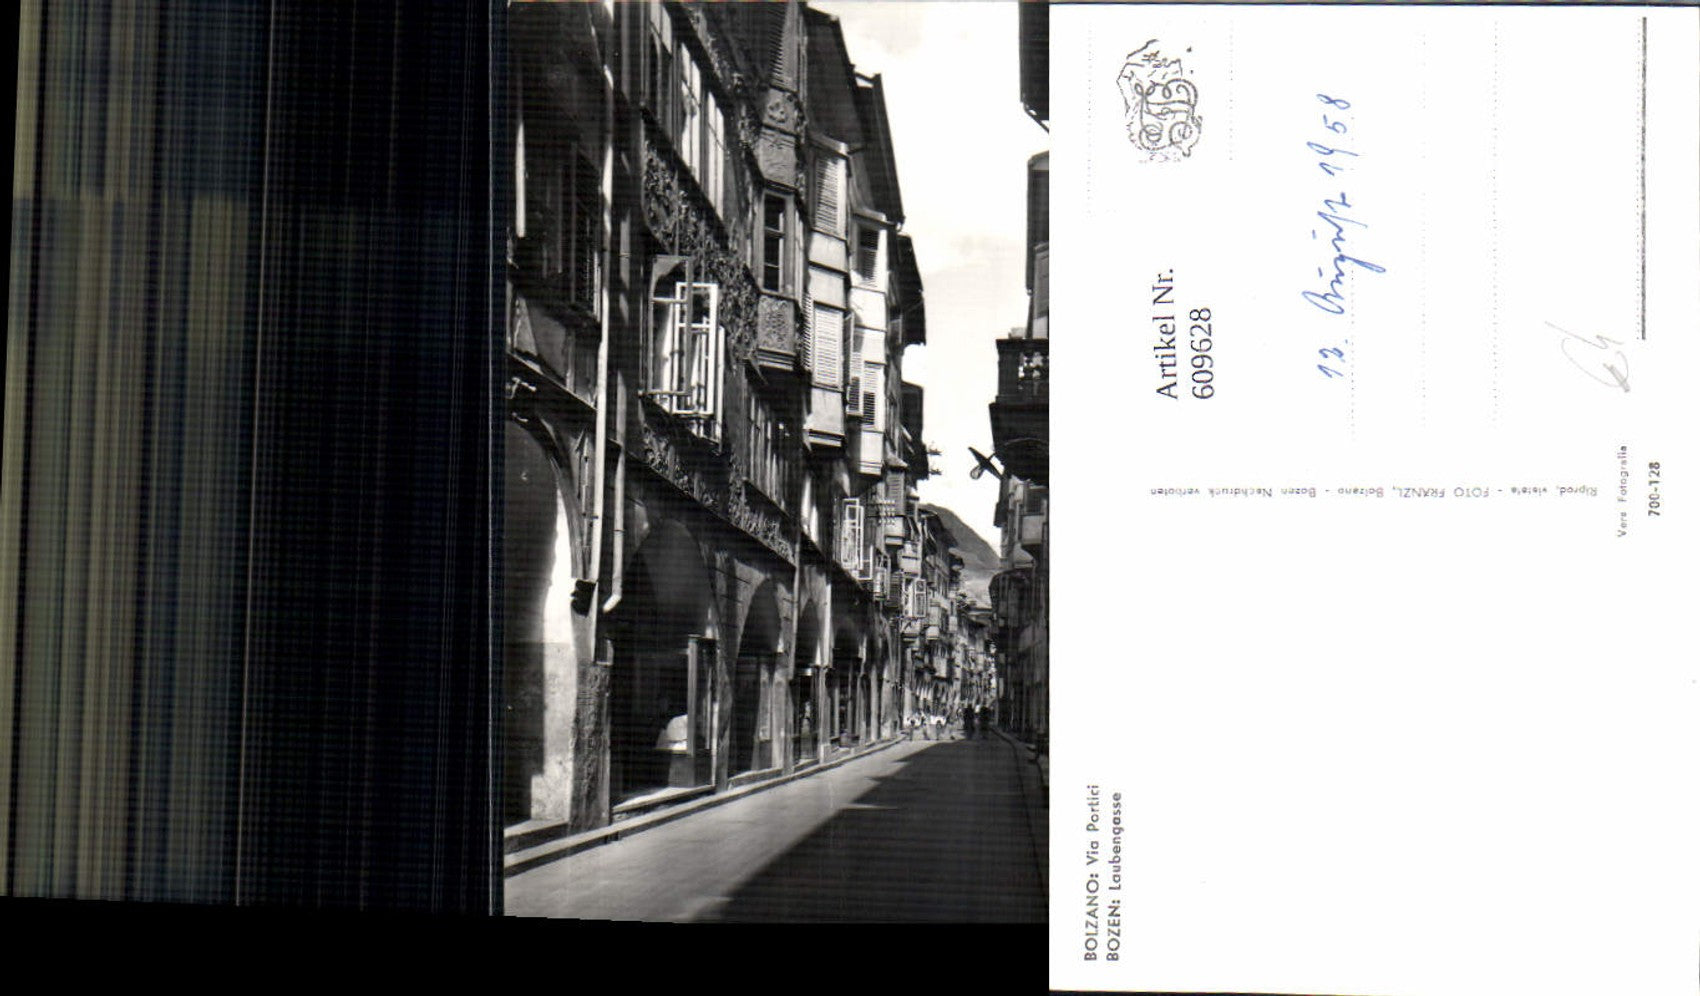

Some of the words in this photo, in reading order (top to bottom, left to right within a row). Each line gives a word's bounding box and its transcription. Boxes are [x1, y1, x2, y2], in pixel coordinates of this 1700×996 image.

[1306, 93, 1359, 177] 1958
[1151, 268, 1175, 306] Nr.
[1151, 314, 1179, 401] Artikel
[1188, 306, 1216, 400] 609628
[1150, 487, 1201, 498] verboten
[1207, 487, 1273, 499] Nachdruck
[1280, 486, 1317, 499] Bozen
[1337, 486, 1385, 499] Bolzano
[1453, 486, 1490, 498] FOTO
[1647, 460, 1661, 517] 700-128
[1085, 784, 1100, 833] Portici
[1085, 840, 1100, 867] Via
[1107, 791, 1125, 891] Laubengasse
[1084, 872, 1100, 962] BOLZANO:
[1106, 898, 1122, 962] BOZEN:
